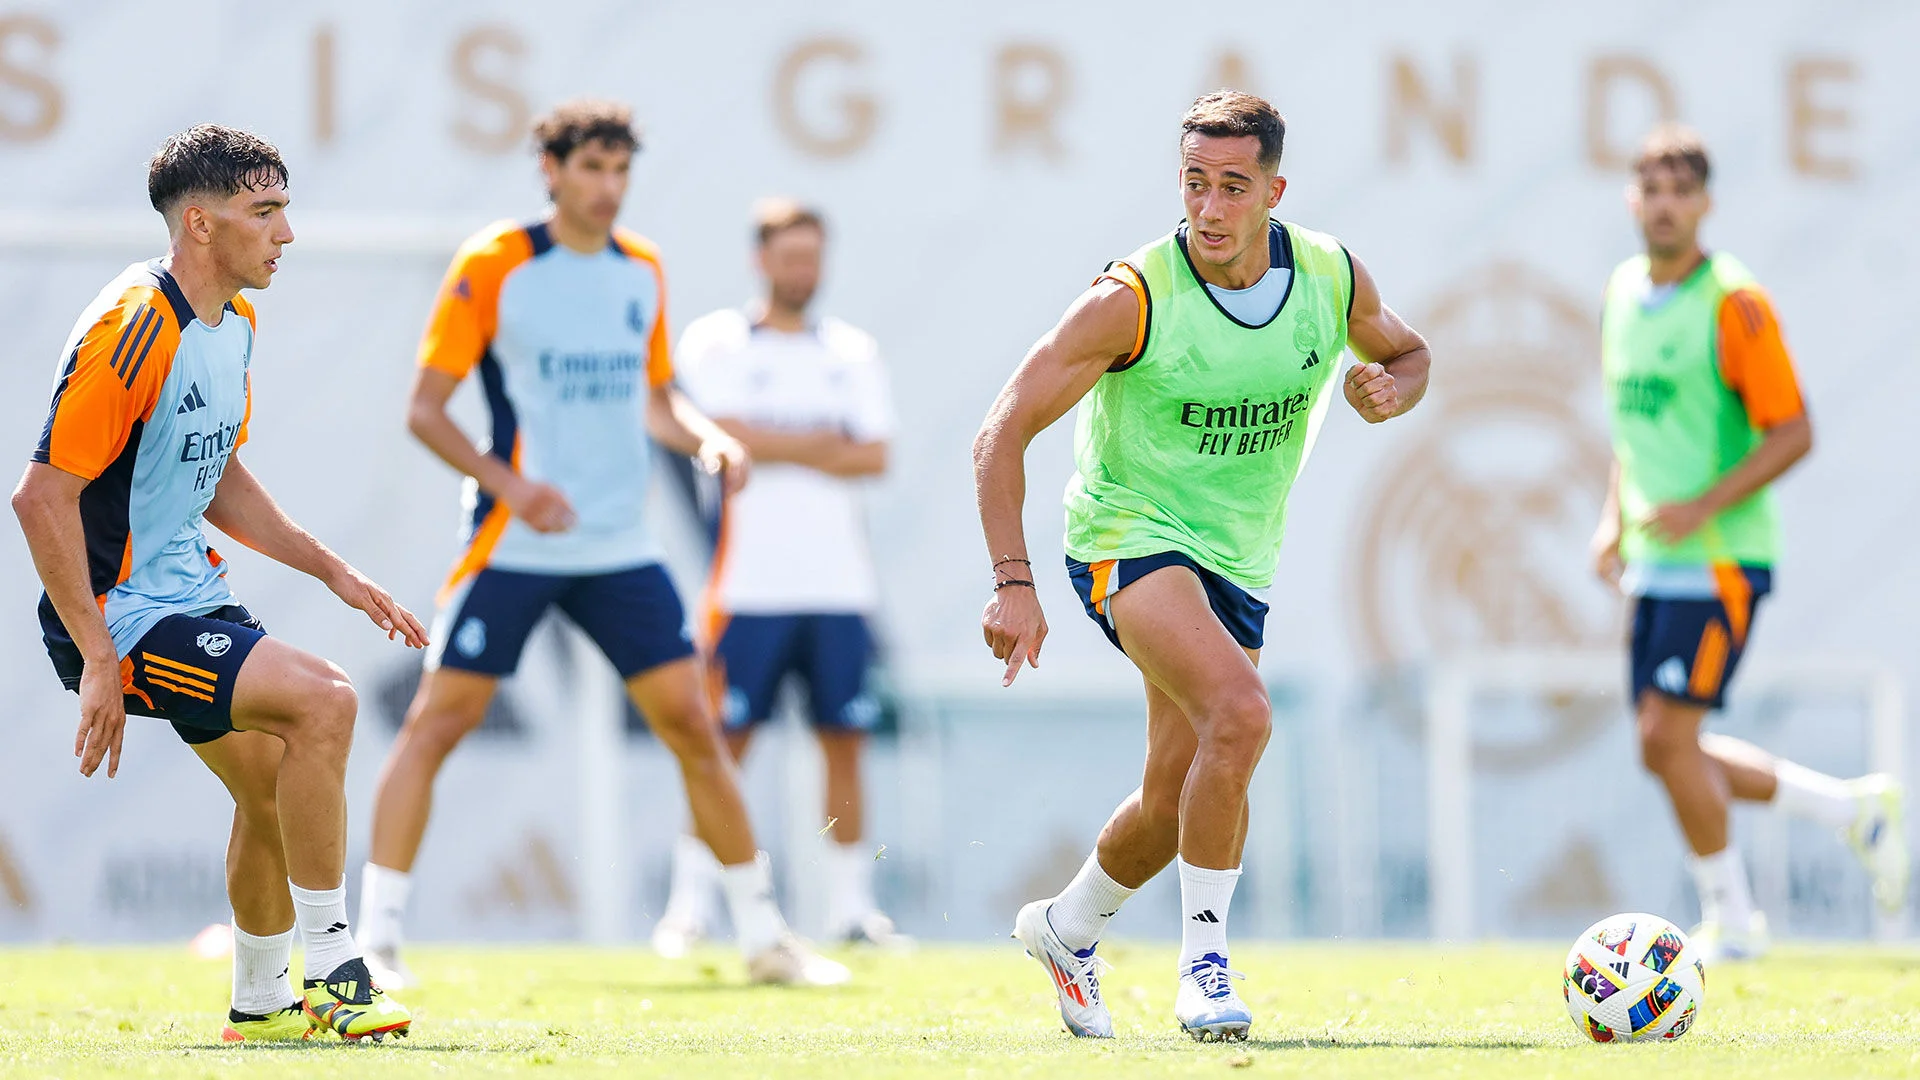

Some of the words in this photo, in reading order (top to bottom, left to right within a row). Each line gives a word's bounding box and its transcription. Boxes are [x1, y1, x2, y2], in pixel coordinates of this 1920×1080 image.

[312, 26, 533, 155] IS
[1181, 387, 1312, 428] Emirates
[1198, 432, 1234, 456] FLY
[1236, 418, 1294, 456] BETTER
